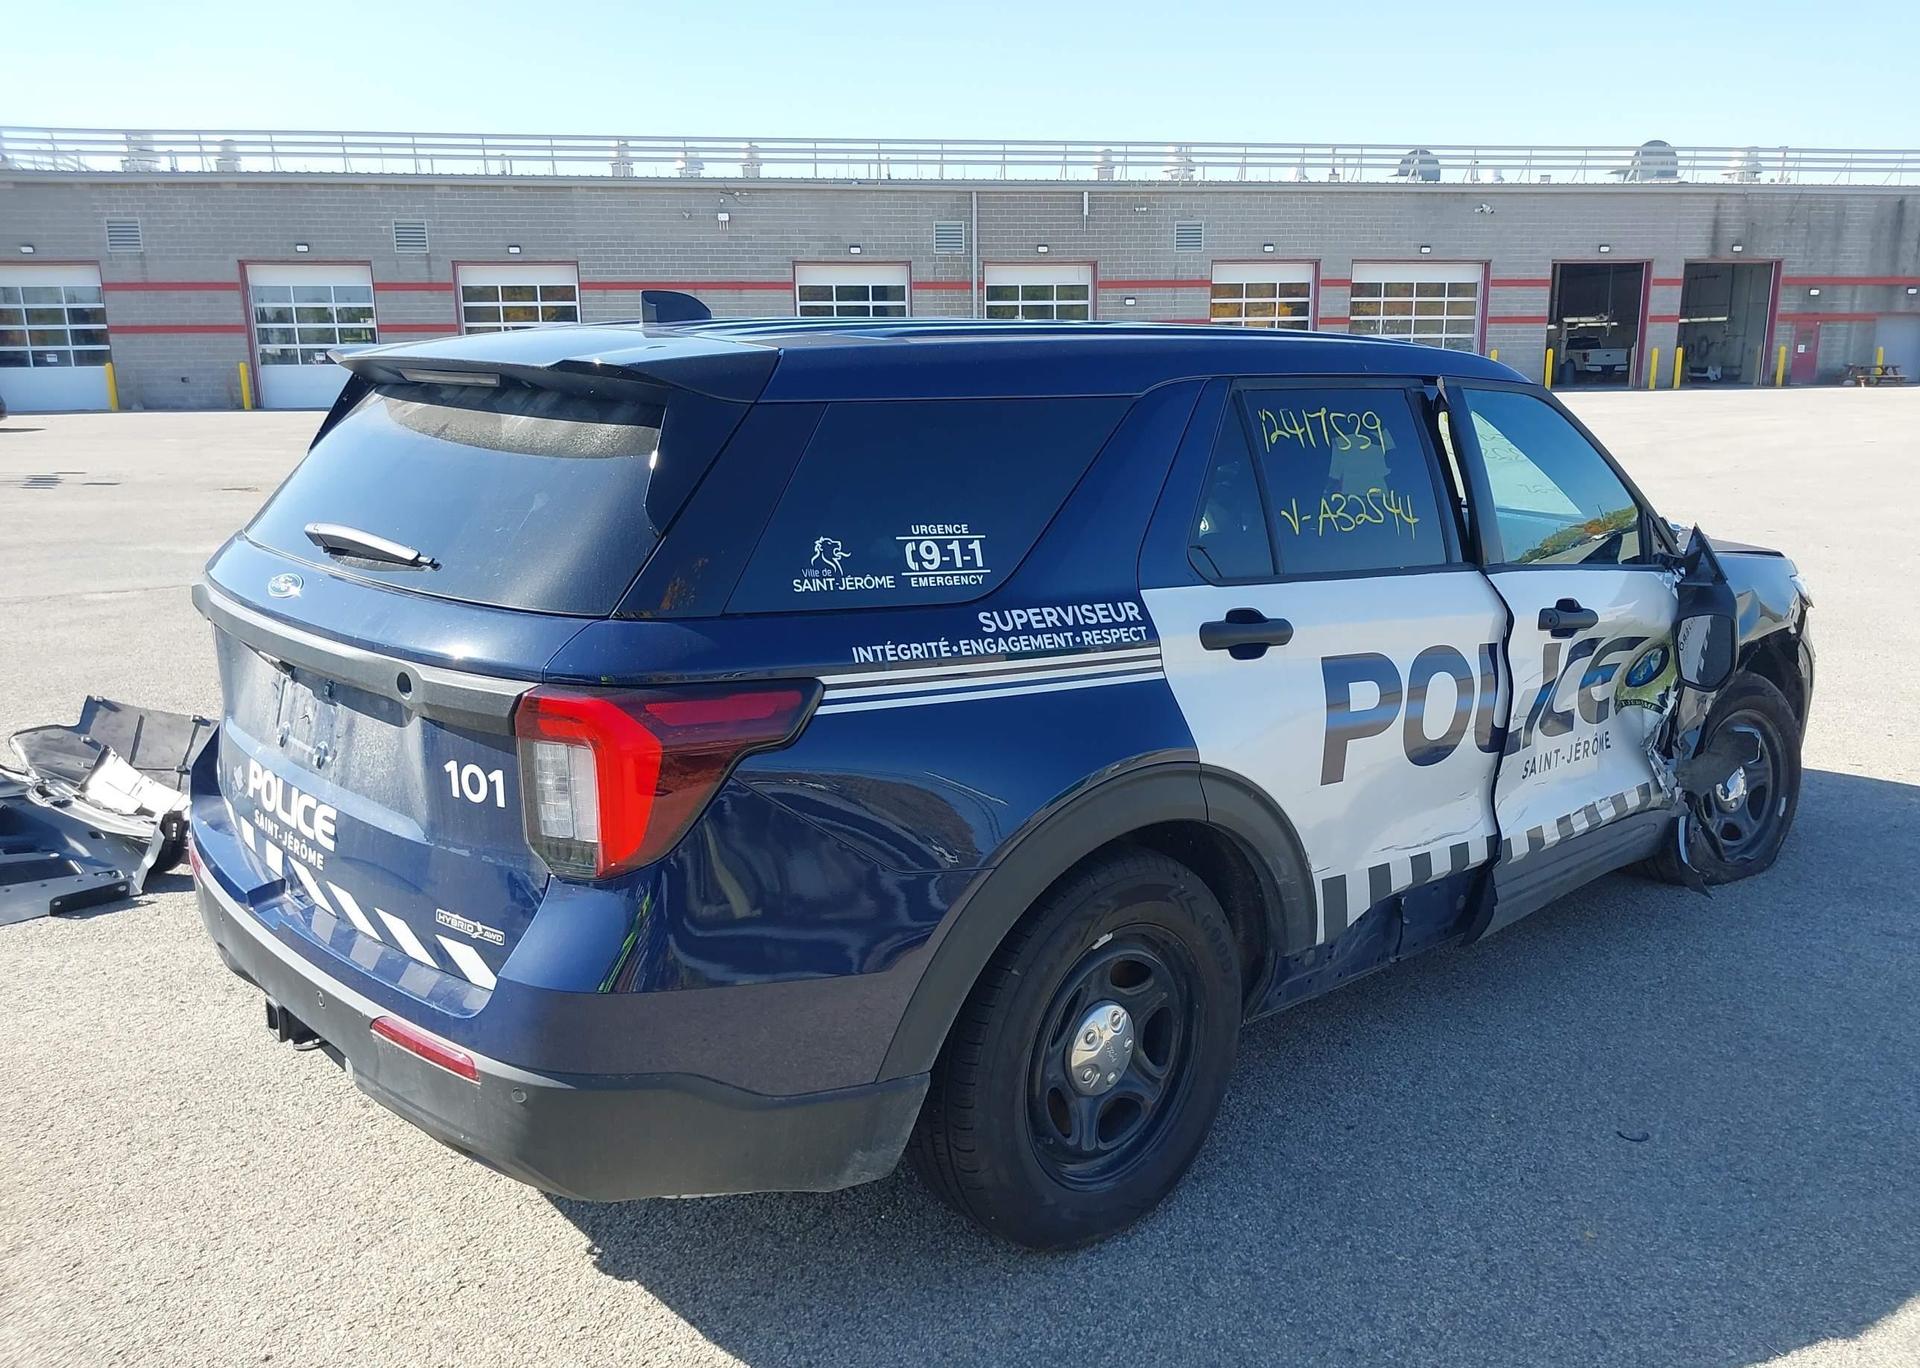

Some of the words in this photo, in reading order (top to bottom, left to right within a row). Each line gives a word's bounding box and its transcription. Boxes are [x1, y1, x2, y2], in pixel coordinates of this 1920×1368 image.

[911, 524, 969, 535] URGENCE
[918, 539, 984, 571] 9-1-1
[793, 574, 896, 592] SAINT-JÉRÔME
[801, 568, 820, 578] Ville
[821, 568, 832, 577] de
[910, 575, 984, 588] EMERGENCY
[977, 601, 1143, 633] SUPERVISEUR
[1320, 636, 1652, 786] POLICE
[443, 759, 506, 808] 101
[248, 758, 338, 853] POLICE
[254, 808, 325, 872] SAINT-JÉRÔME
[438, 912, 474, 934] HYBRID
[483, 930, 503, 942] AWD
